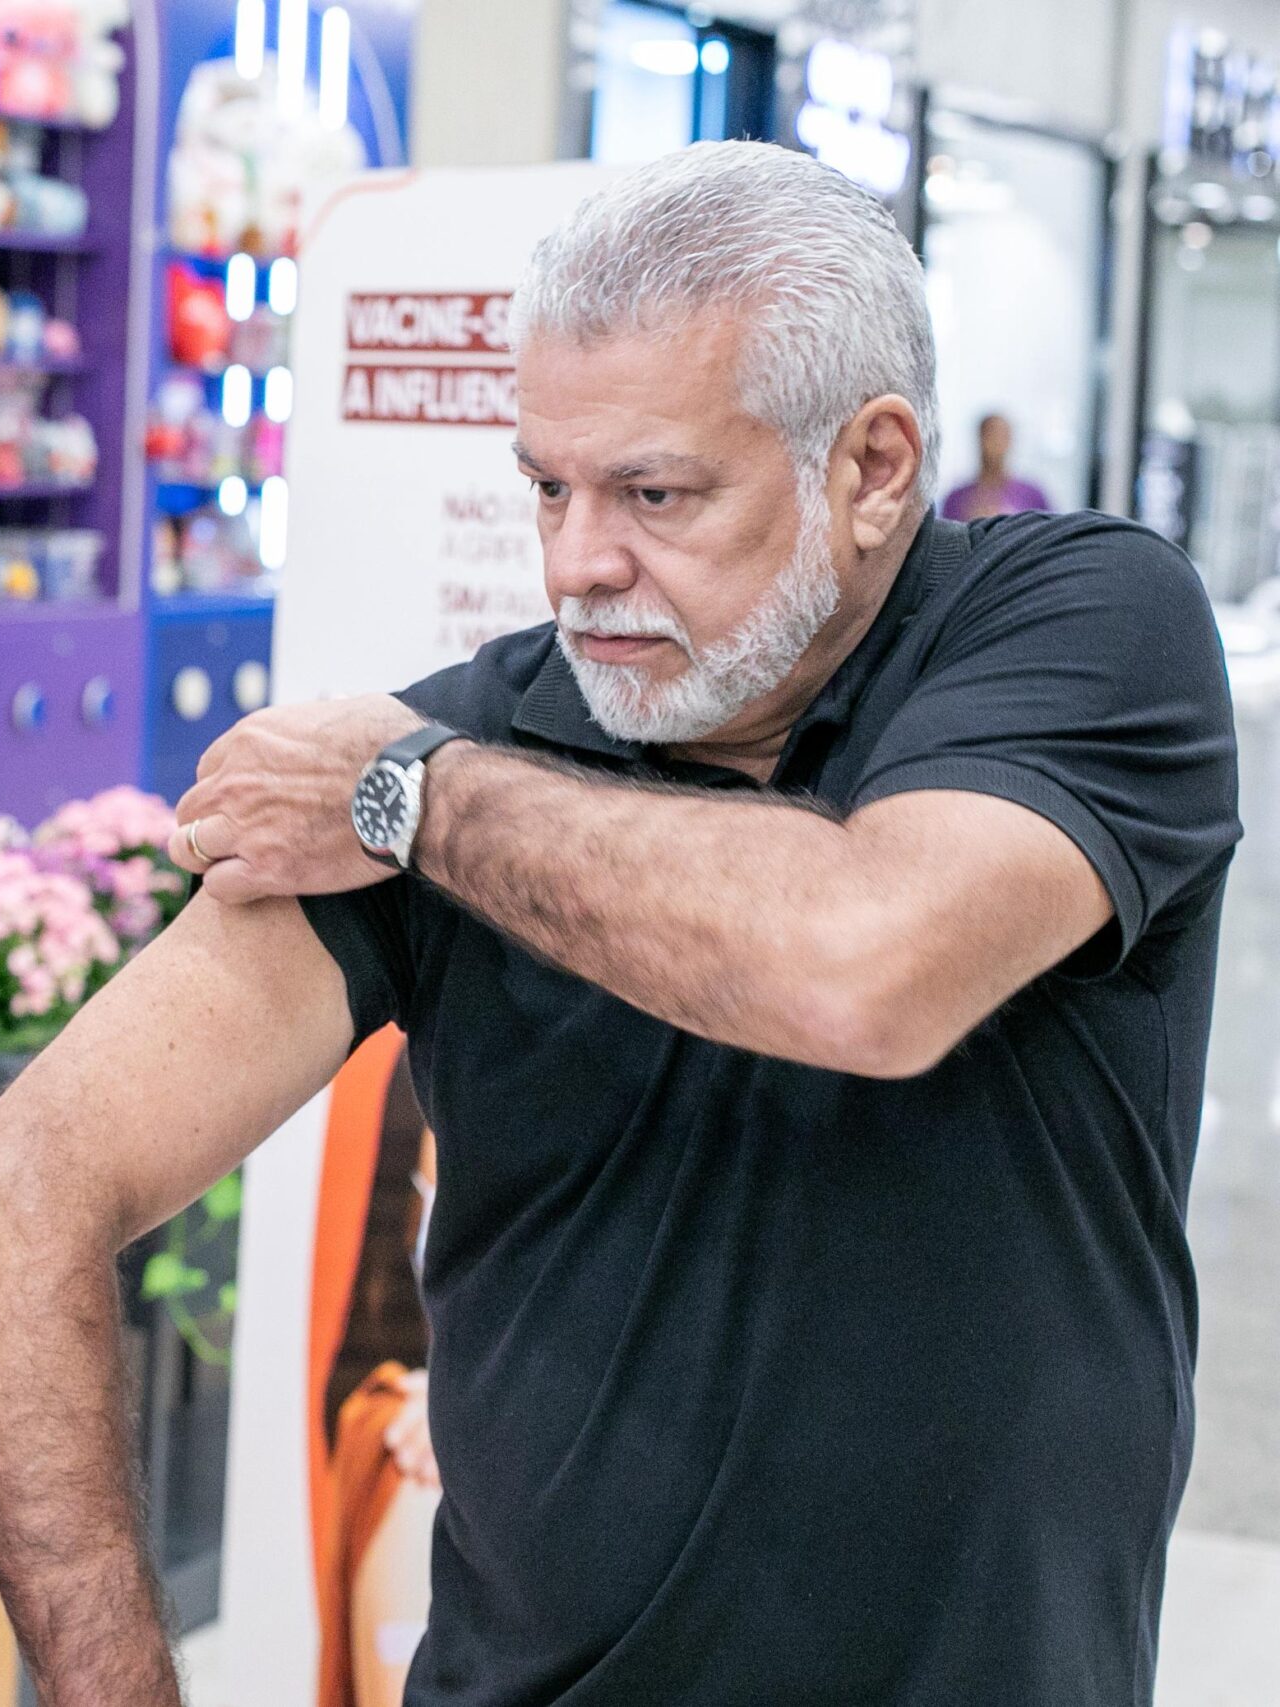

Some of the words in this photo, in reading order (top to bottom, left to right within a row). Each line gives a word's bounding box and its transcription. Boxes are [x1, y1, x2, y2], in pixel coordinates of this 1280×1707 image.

[350, 297, 510, 349] VACINE-S
[343, 366, 371, 415] A
[374, 367, 517, 421] INFLUENC
